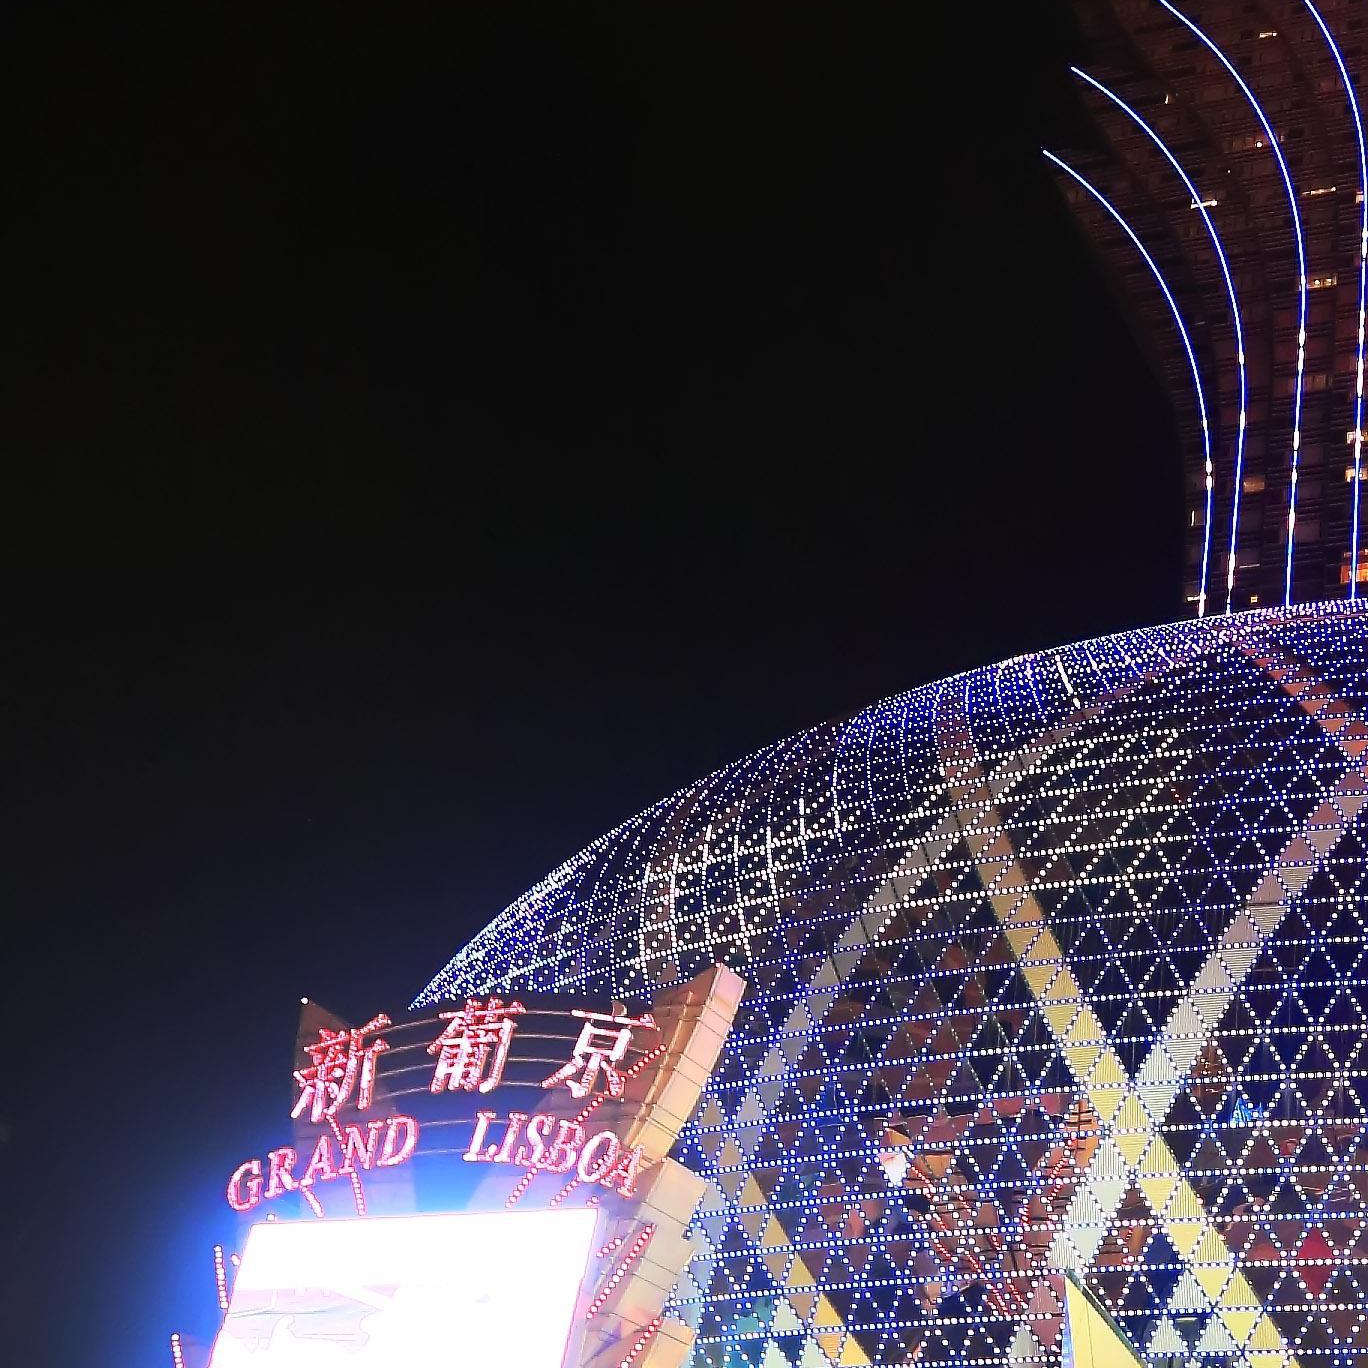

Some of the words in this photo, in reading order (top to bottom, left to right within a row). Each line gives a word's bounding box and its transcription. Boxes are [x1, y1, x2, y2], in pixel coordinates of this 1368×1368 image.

[290, 997, 660, 1120] 新葡京
[226, 1115, 419, 1212] GRAND
[462, 1111, 646, 1199] LISBOA
